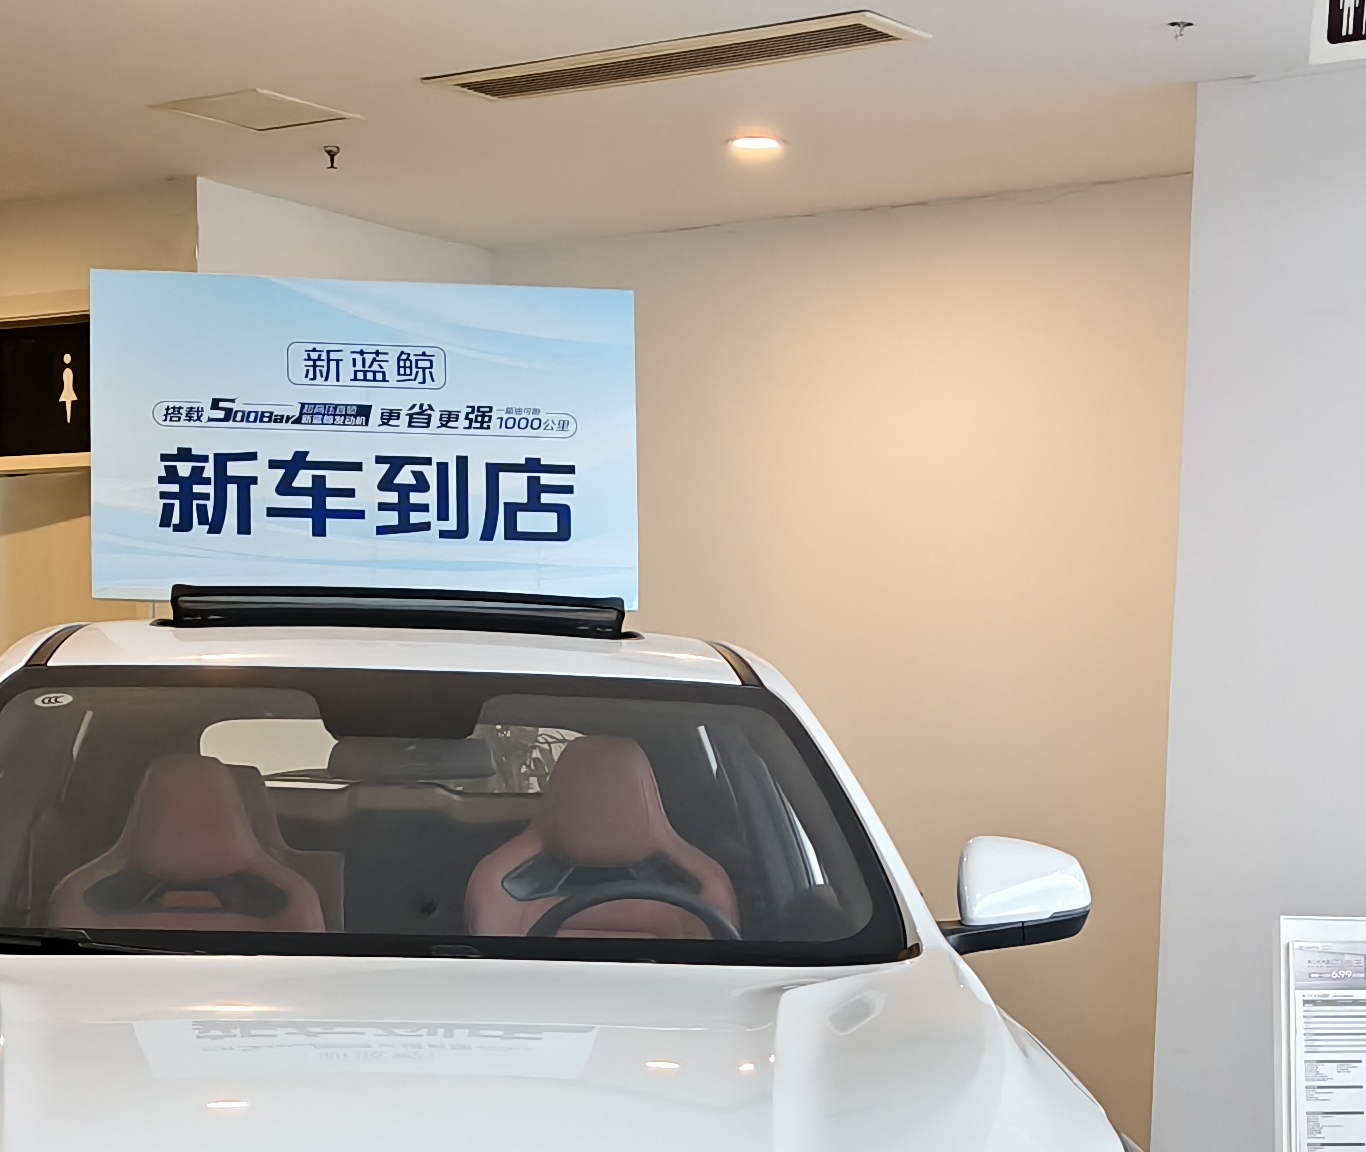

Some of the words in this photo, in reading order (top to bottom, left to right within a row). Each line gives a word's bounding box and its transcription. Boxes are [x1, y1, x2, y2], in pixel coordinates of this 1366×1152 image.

[302, 347, 436, 385] 新蓝鲸
[377, 402, 494, 430] 更省更强
[156, 446, 577, 542] 新车到店
